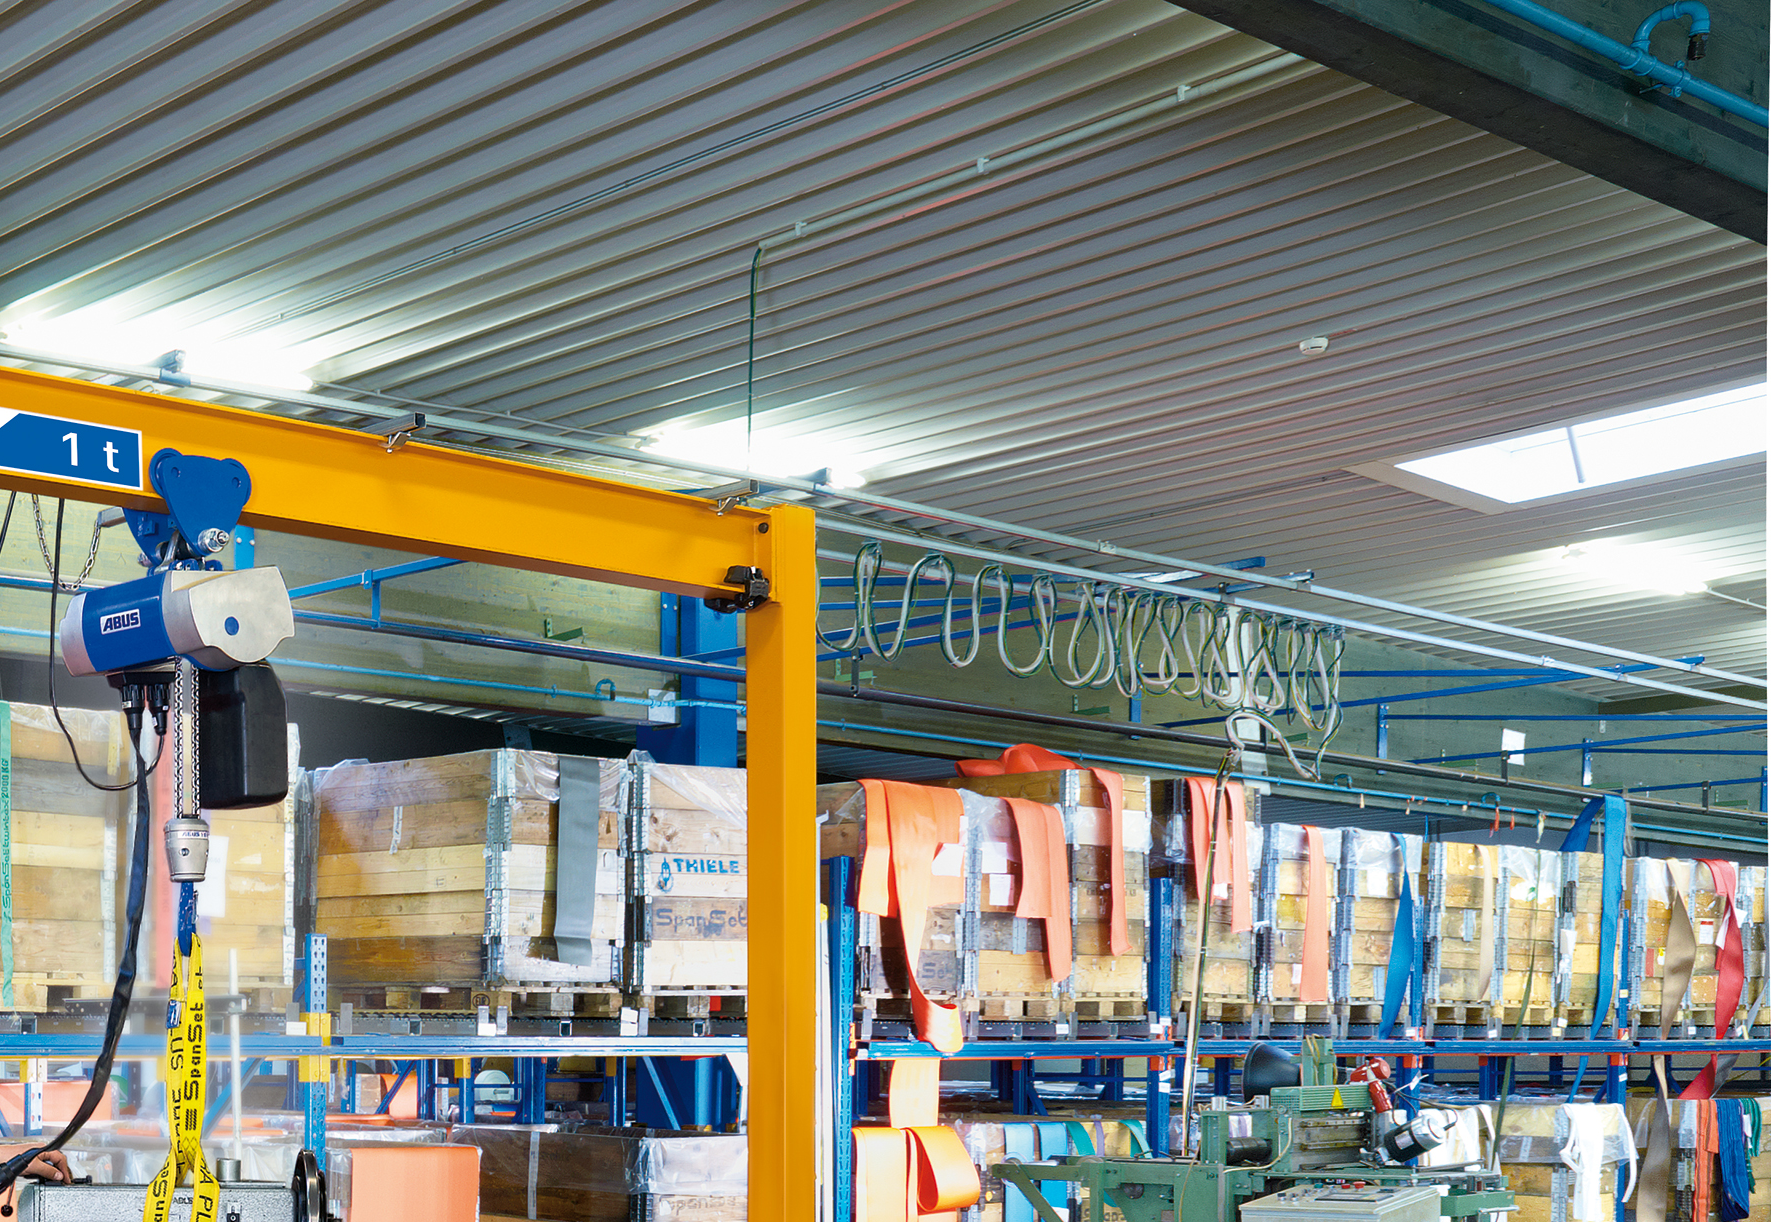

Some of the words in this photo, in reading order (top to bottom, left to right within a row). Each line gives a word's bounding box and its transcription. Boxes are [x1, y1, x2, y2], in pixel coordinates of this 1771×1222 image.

[62, 431, 79, 466] 1
[102, 440, 120, 473] t
[103, 611, 139, 634] ABUS
[1, 774, 10, 798] 2000
[2, 801, 10, 847] twintex
[2, 848, 12, 909] SpanSet
[672, 858, 740, 874] THIELE
[655, 907, 748, 933] SpanSet
[184, 1002, 204, 1101] SpanSet
